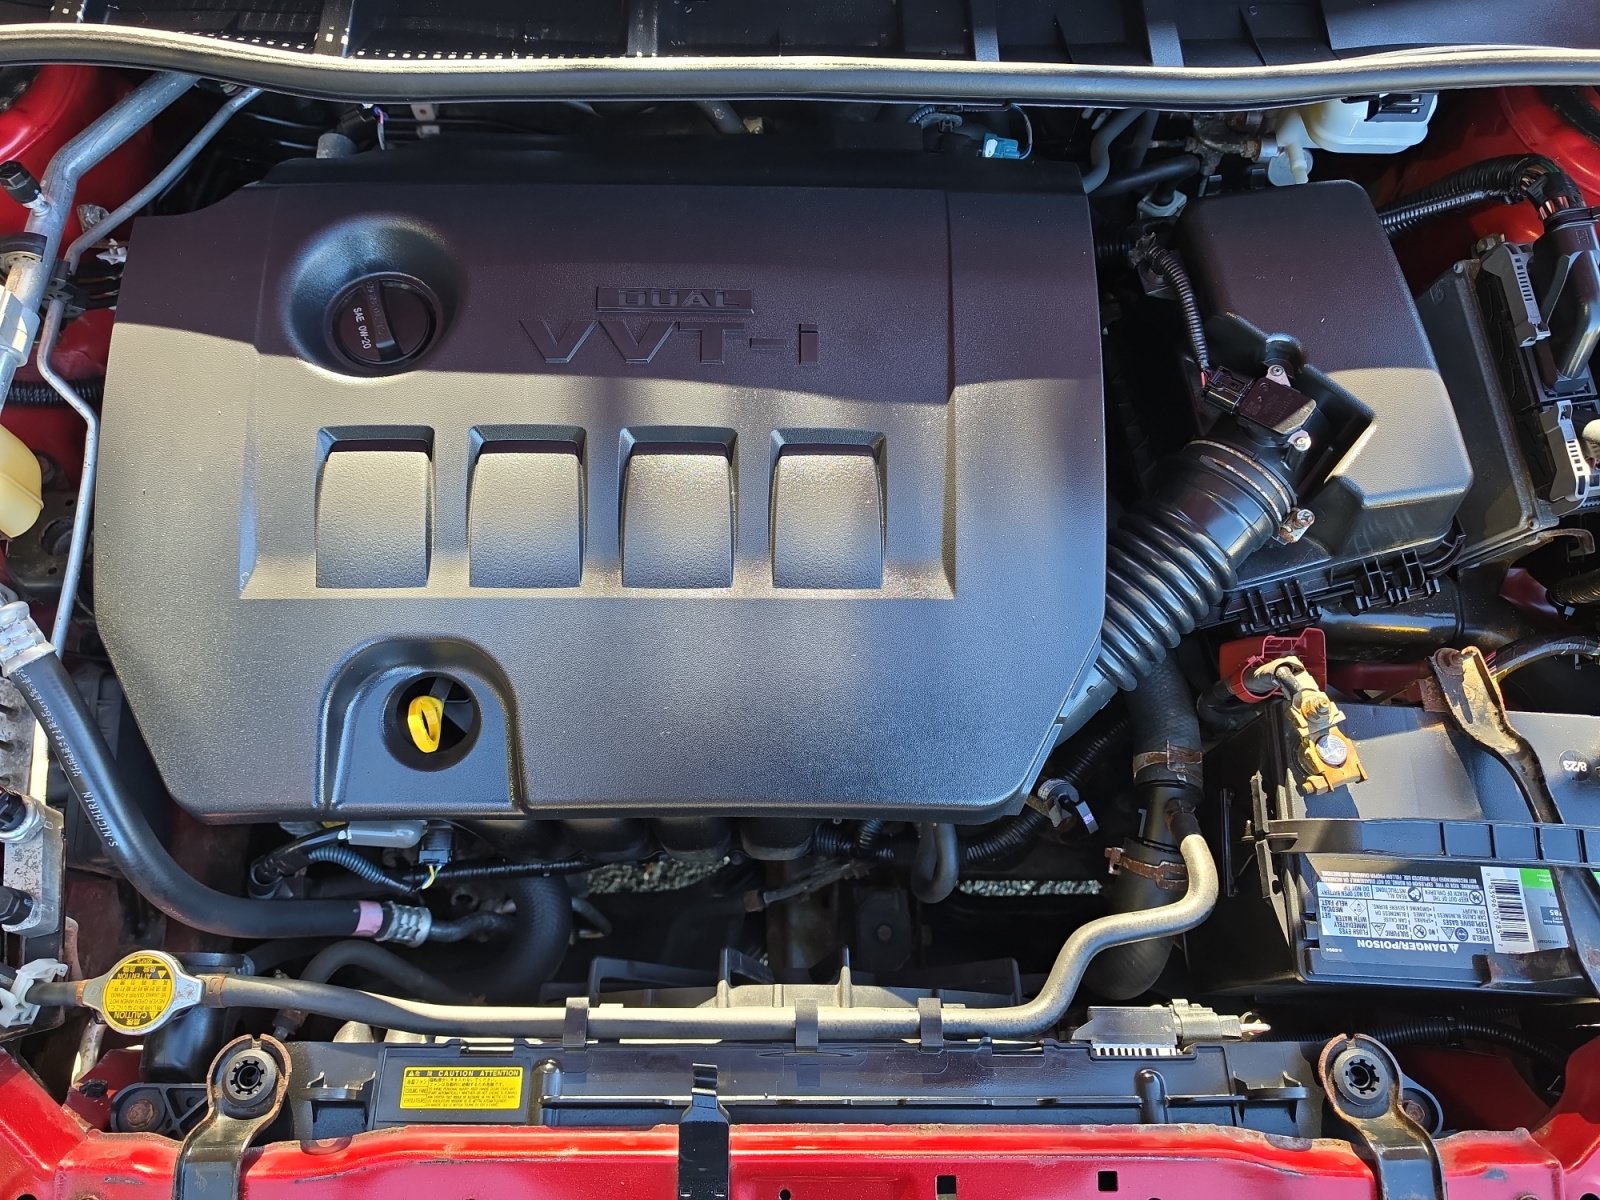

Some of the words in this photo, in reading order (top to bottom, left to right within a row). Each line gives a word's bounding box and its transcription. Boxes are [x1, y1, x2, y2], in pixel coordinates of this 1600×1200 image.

[618, 290, 740, 306] DUAL
[353, 307, 365, 322] SAE
[358, 326, 372, 349] 0W-20
[1563, 760, 1587, 772] 8/23
[1488, 885, 1497, 908] 83996
[1493, 911, 1502, 934] 05785
[1357, 939, 1447, 952] DANGER/POISON
